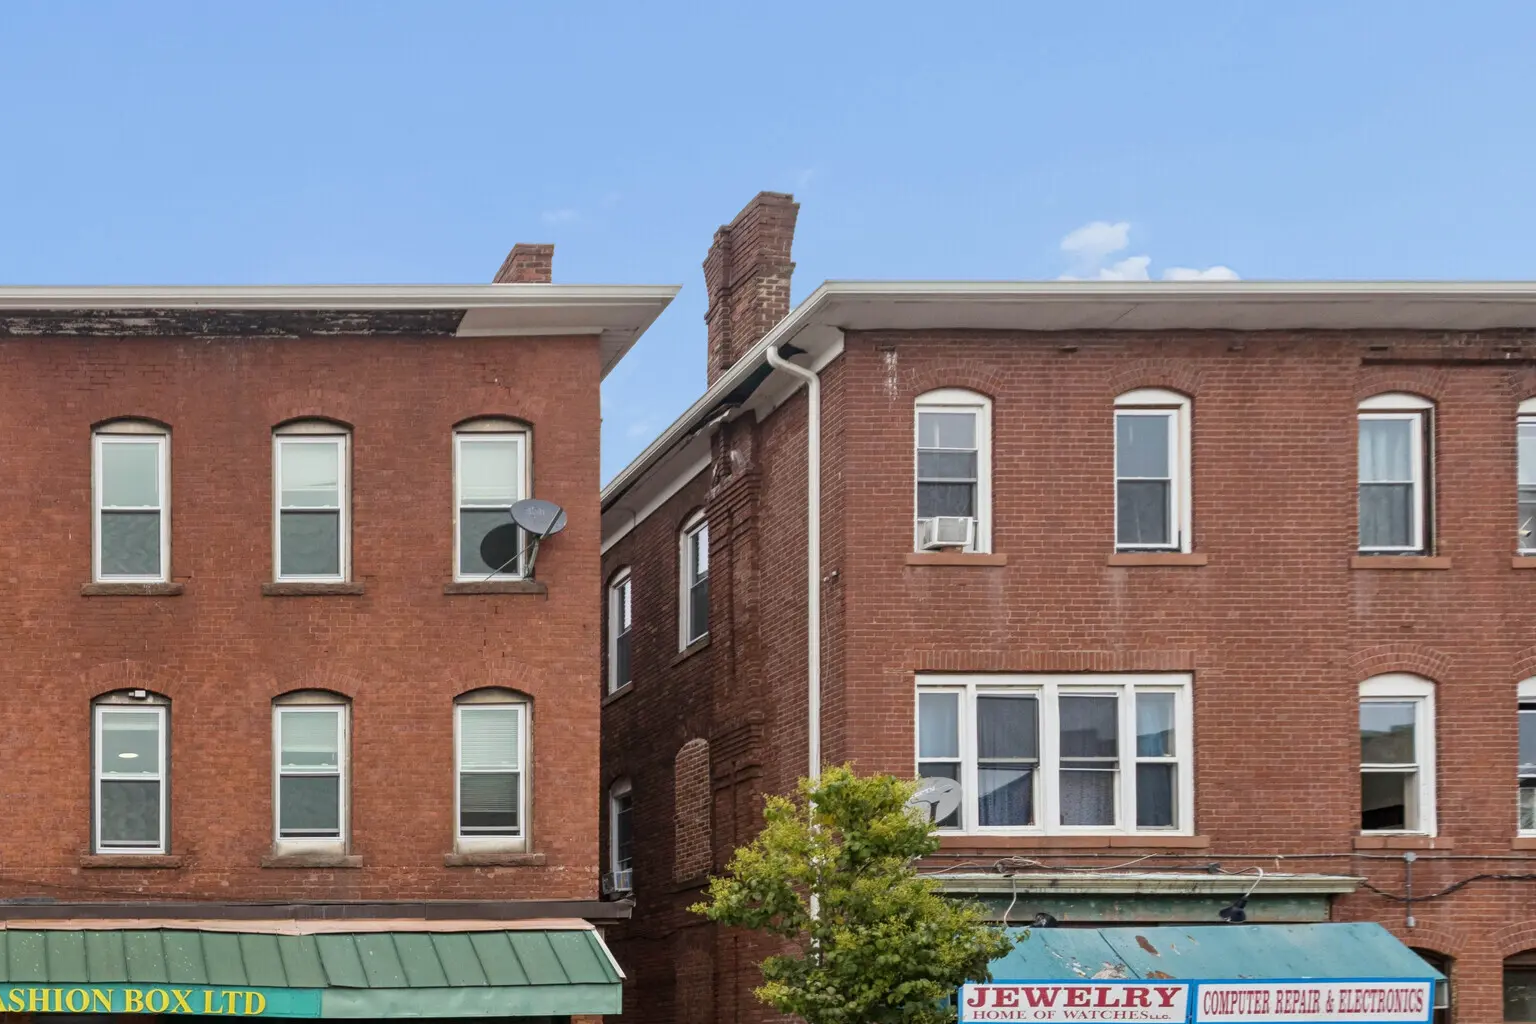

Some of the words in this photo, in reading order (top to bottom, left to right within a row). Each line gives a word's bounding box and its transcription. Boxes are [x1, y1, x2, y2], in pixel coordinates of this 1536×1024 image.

[124, 988, 193, 1013] BOX
[203, 990, 266, 1015] LTD
[967, 987, 1182, 1008] JEWELRY
[1203, 990, 1270, 1015] COMPUTER
[1275, 989, 1320, 1014] REPAIR
[1326, 990, 1335, 1013] &
[1338, 988, 1424, 1013] ELECTRONICS
[973, 1010, 1027, 1020] HOME
[1034, 1010, 1056, 1020] OF
[1064, 1010, 1148, 1020] WATCHES
